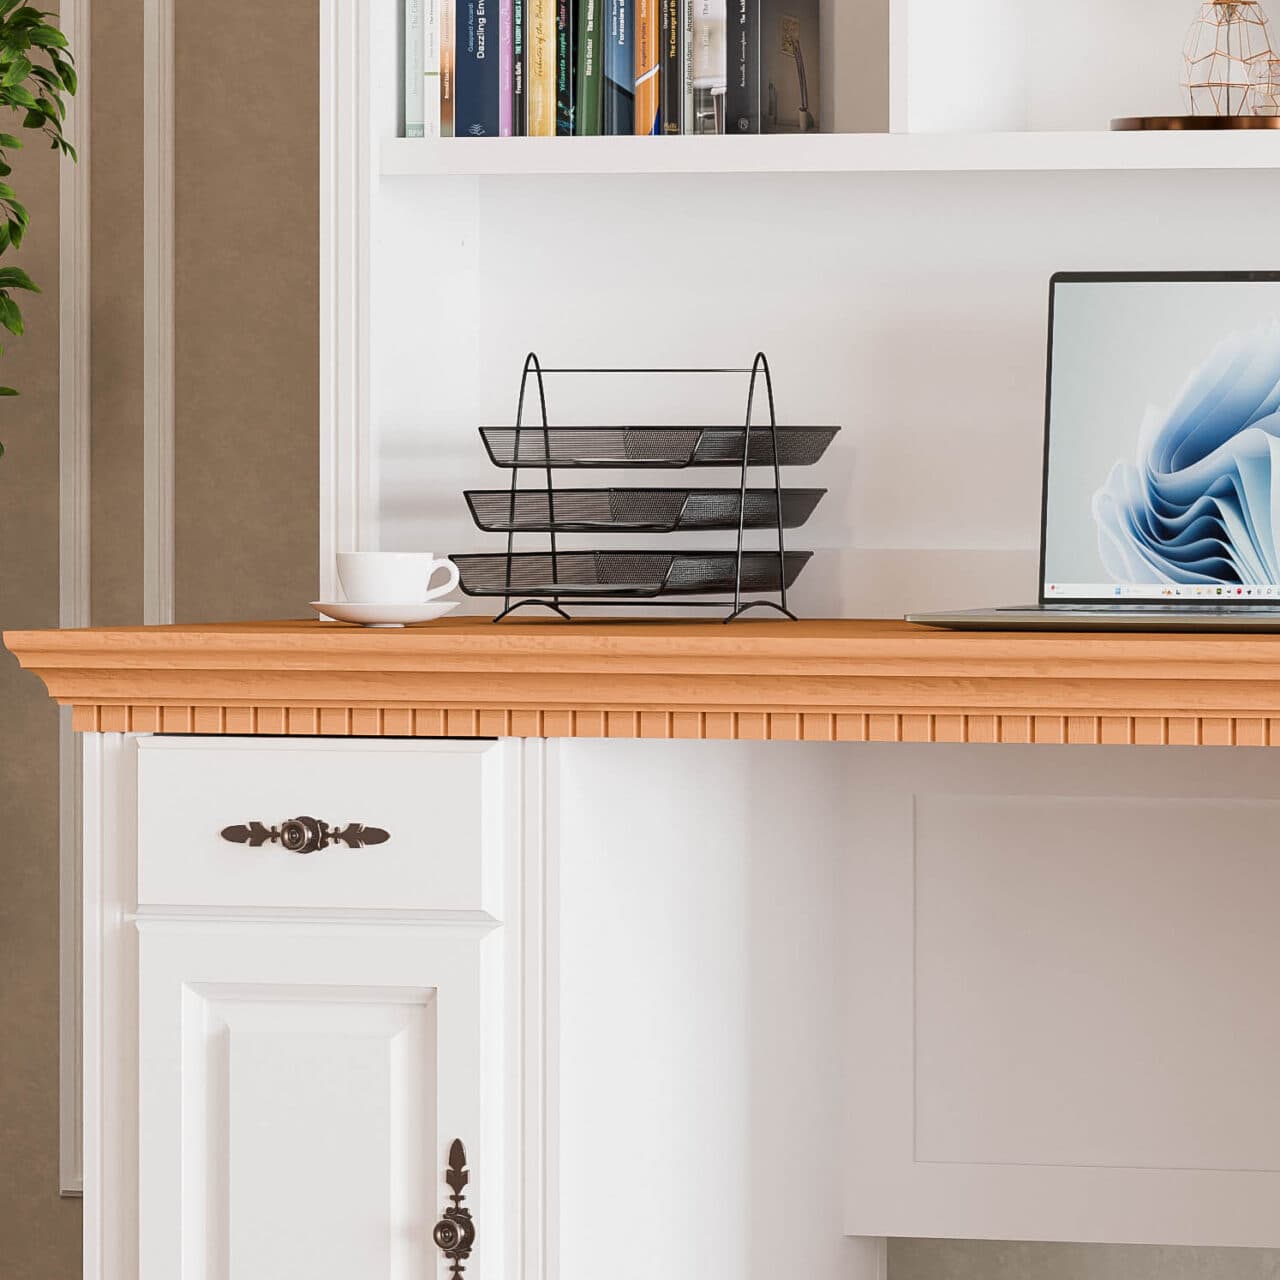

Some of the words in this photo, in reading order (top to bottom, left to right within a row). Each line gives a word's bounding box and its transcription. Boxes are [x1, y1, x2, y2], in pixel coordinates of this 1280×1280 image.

[670, 8, 678, 16] of
[476, 18, 487, 59] Dazzling
[670, 46, 678, 57] The
